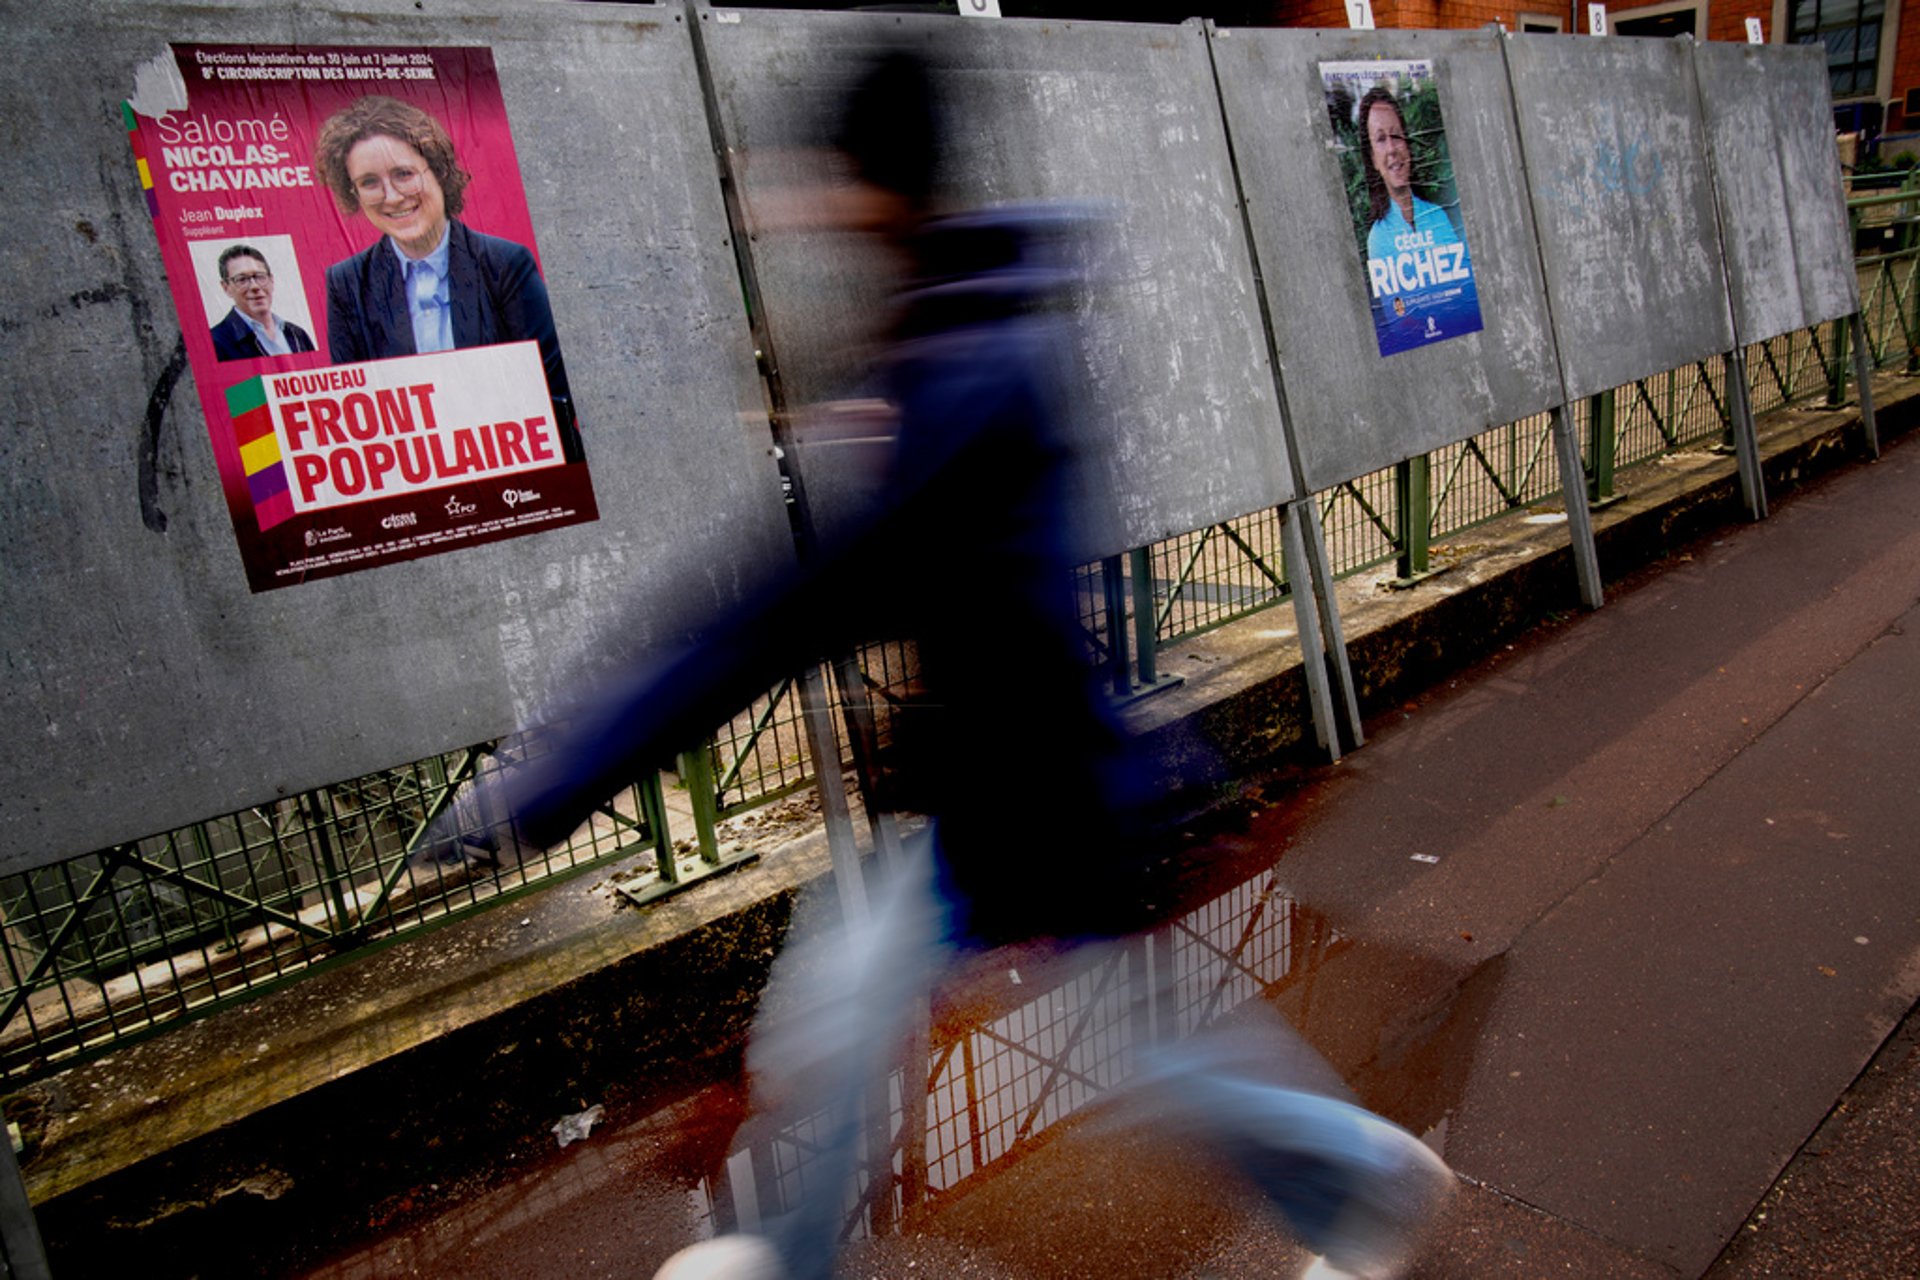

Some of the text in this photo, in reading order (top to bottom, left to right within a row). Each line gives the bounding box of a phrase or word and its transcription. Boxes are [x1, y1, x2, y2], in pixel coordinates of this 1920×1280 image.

[1354, 3, 1364, 26] 7
[1595, 12, 1602, 32] 8
[195, 49, 247, 64] Élections
[307, 52, 326, 64] des
[326, 53, 341, 65] 30
[341, 53, 361, 67] juin
[362, 54, 373, 64] et
[373, 54, 380, 65] 7
[381, 53, 408, 67] juillet
[409, 53, 434, 65] 2024
[217, 66, 321, 79] CIRCONSCRIPTION
[322, 67, 345, 79] DES
[346, 67, 435, 80] HAUTS-DE-SEINE
[156, 112, 289, 144] Salomé
[162, 144, 290, 168] NICOLAS-
[169, 166, 314, 192] CHAVANCE
[180, 205, 264, 223] Jean Duplex
[1395, 229, 1434, 251] CÉCILE
[1366, 243, 1470, 298] RICHEZ
[273, 368, 367, 398] NOUVEAU
[279, 383, 436, 451] FRONT
[293, 416, 555, 503] POPULAIRE
